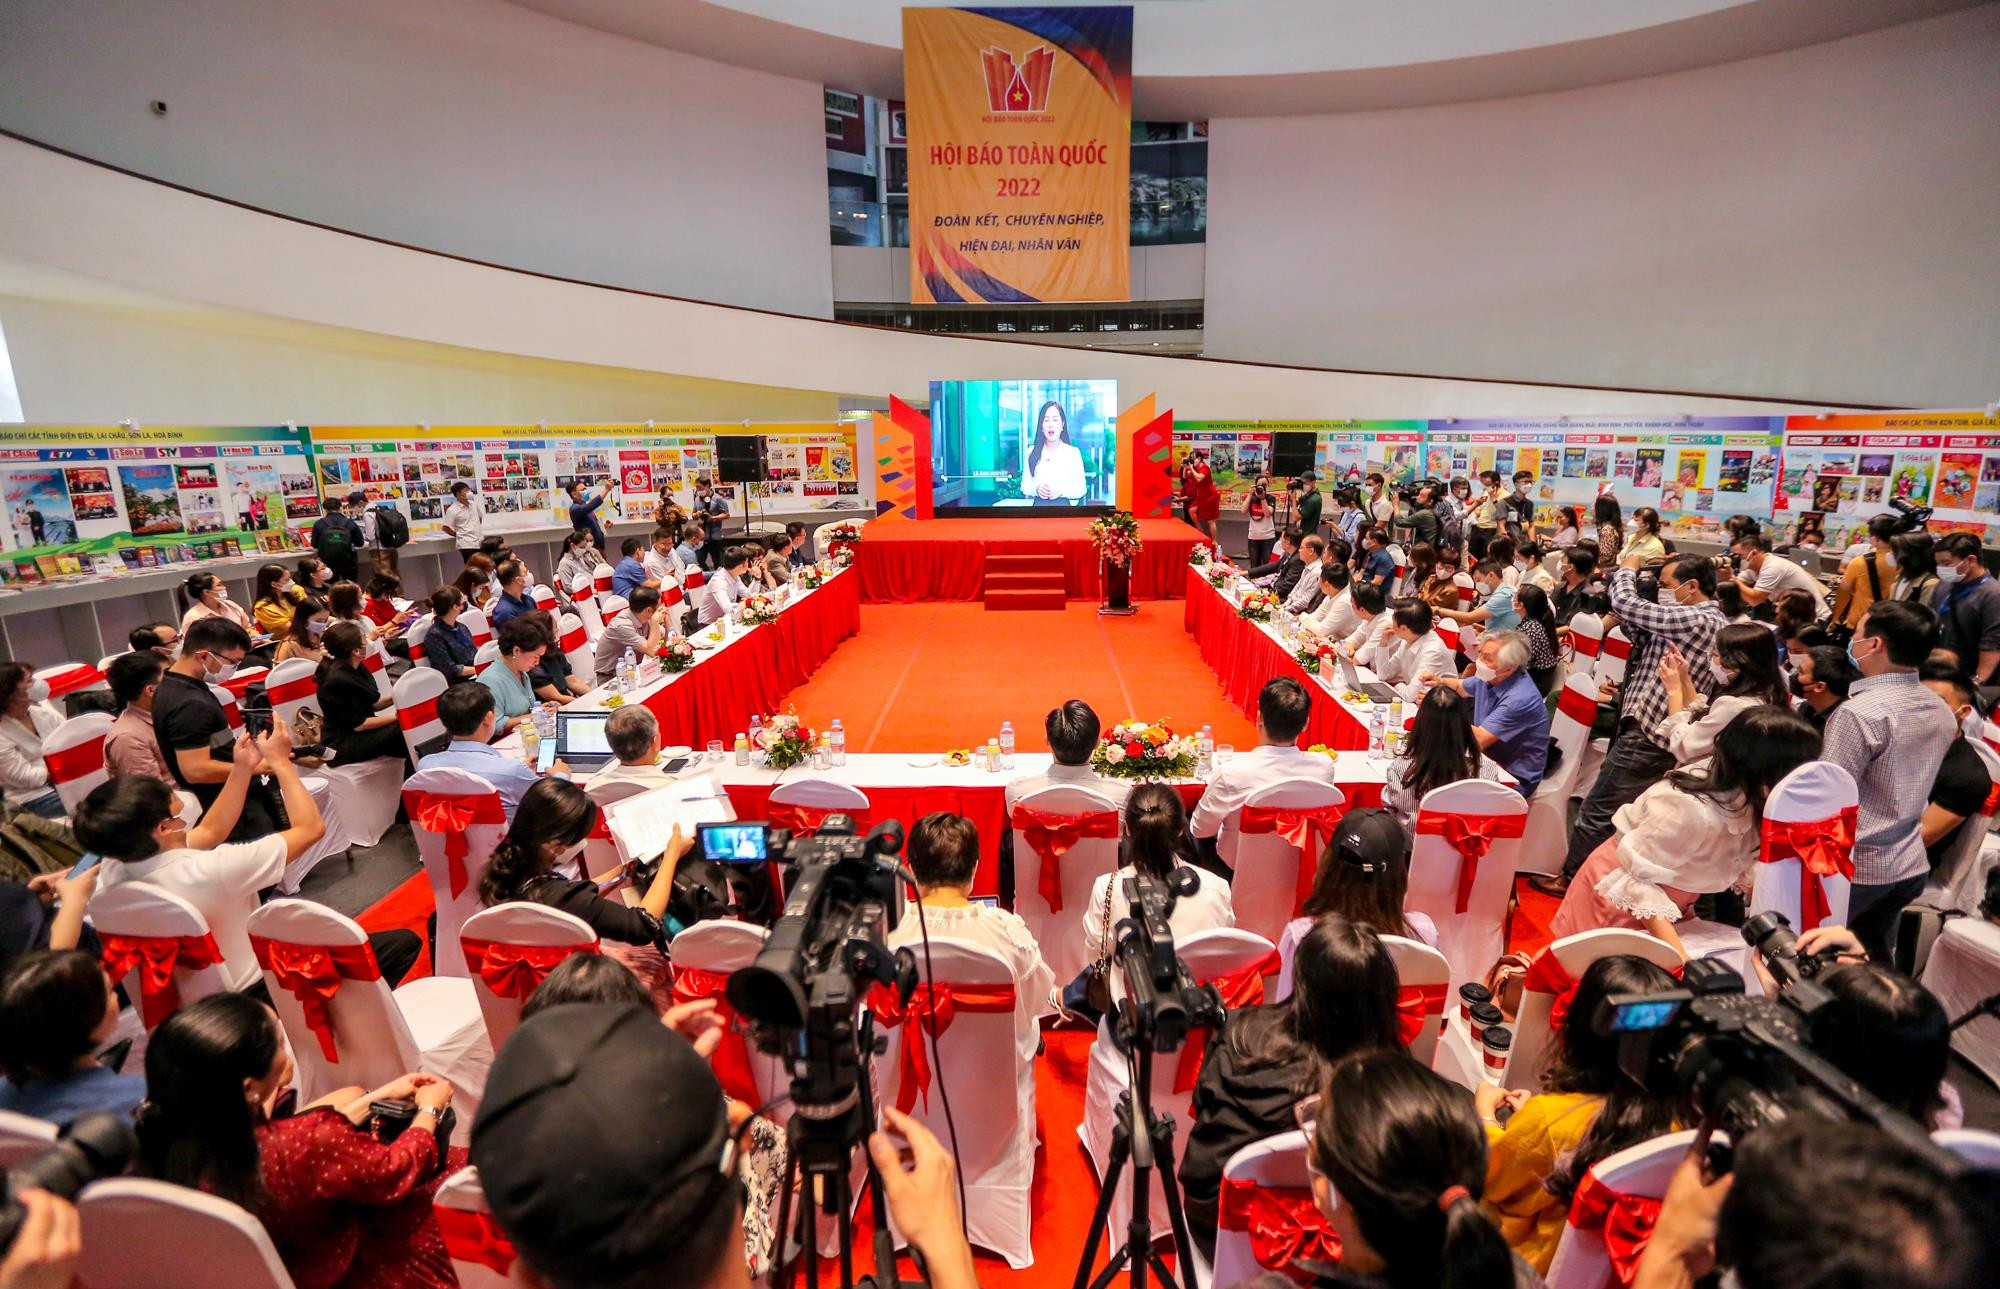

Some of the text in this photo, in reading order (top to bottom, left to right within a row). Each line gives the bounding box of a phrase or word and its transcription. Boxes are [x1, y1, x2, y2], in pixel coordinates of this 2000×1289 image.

[930, 138, 1108, 172] HỘI BÁO TOÀN QUỐC
[996, 178, 1040, 197] 2022
[934, 212, 1105, 228] ĐOÀN KẾT, CHUYÊN NGHIỆP,
[960, 239, 1082, 256] HIỆN ĐẠI, NHÂN VĂN
[50, 451, 73, 459] LTV
[158, 448, 178, 457] STV
